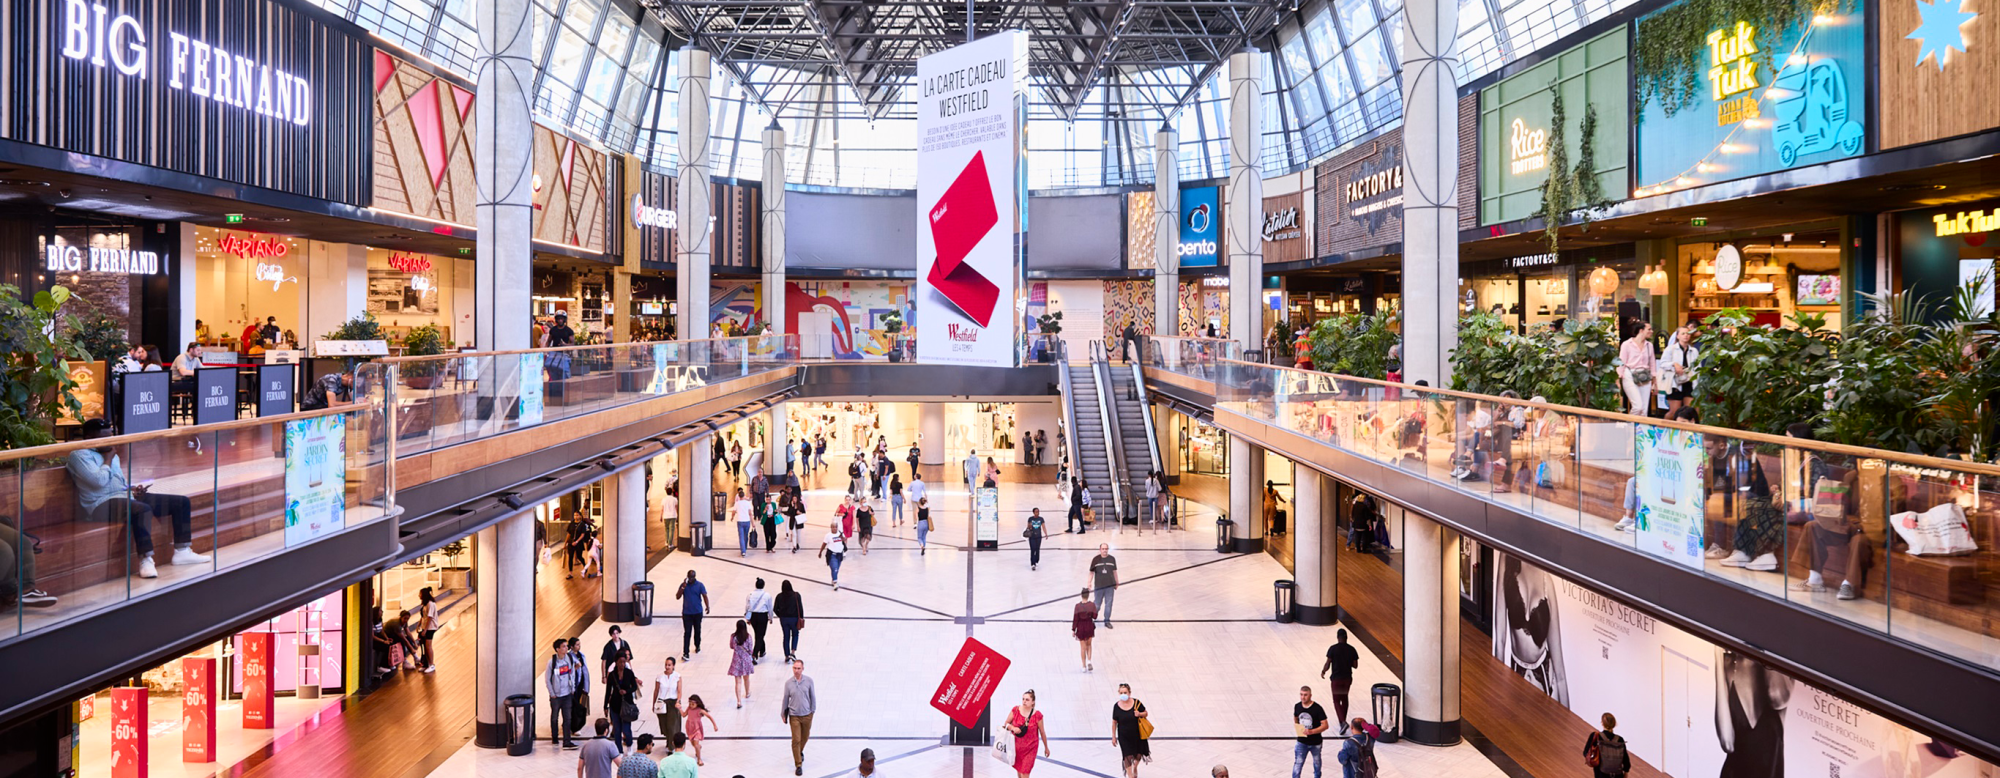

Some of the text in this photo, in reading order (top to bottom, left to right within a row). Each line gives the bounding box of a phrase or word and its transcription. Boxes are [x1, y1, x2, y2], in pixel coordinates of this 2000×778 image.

[1707, 20, 1759, 67] Tuk
[63, 0, 309, 126] BIG FERNAND
[924, 59, 1005, 98] LA CARTE CADEAU
[1708, 57, 1759, 101] Tuk
[939, 89, 988, 118] WESTFIELD
[958, 120, 972, 129] CADEAU
[975, 116, 989, 126] OFFREZ
[994, 114, 1002, 122] BON
[923, 136, 936, 144] CADEAU
[980, 125, 996, 134] VALABLE
[996, 122, 1006, 130] DANS
[961, 136, 986, 145] RESTAURANTS
[1511, 118, 1544, 160] Rice
[642, 205, 677, 229] URGER
[932, 203, 947, 224] Westfield
[218, 233, 287, 259] VAPIANO
[1177, 239, 1216, 256] bento
[47, 245, 157, 275] BIG FERNAND
[389, 251, 432, 273] VAPIANO
[1717, 255, 1738, 274] Rice
[948, 323, 978, 342] Westfield
[962, 344, 973, 352] TEMPS
[211, 386, 222, 396] BIG
[272, 381, 281, 390] BIG
[140, 391, 153, 403] BIG
[205, 396, 228, 407] FERNAND
[266, 390, 286, 401] FERNAND
[133, 402, 160, 415] FERNAND
[304, 453, 327, 466] SECRET
[306, 444, 328, 457] JARDIN
[1655, 456, 1682, 471] JARDIN
[1655, 467, 1681, 482] SECRET
[1562, 578, 1614, 616] VICTORIA'S
[1618, 604, 1656, 635] SECRET
[1582, 608, 1605, 624] OUVERTURE
[1606, 618, 1630, 636] PROCHAINE
[243, 664, 266, 677] -60%
[958, 651, 976, 677] CARTE CADEAU
[183, 692, 207, 706] -60%
[938, 681, 957, 705] Westfield
[1814, 695, 1860, 727] SECRET
[112, 725, 138, 740] -60%
[1797, 708, 1875, 751] OUVERTURE PROCHAINE
[996, 741, 1007, 753] C&A
